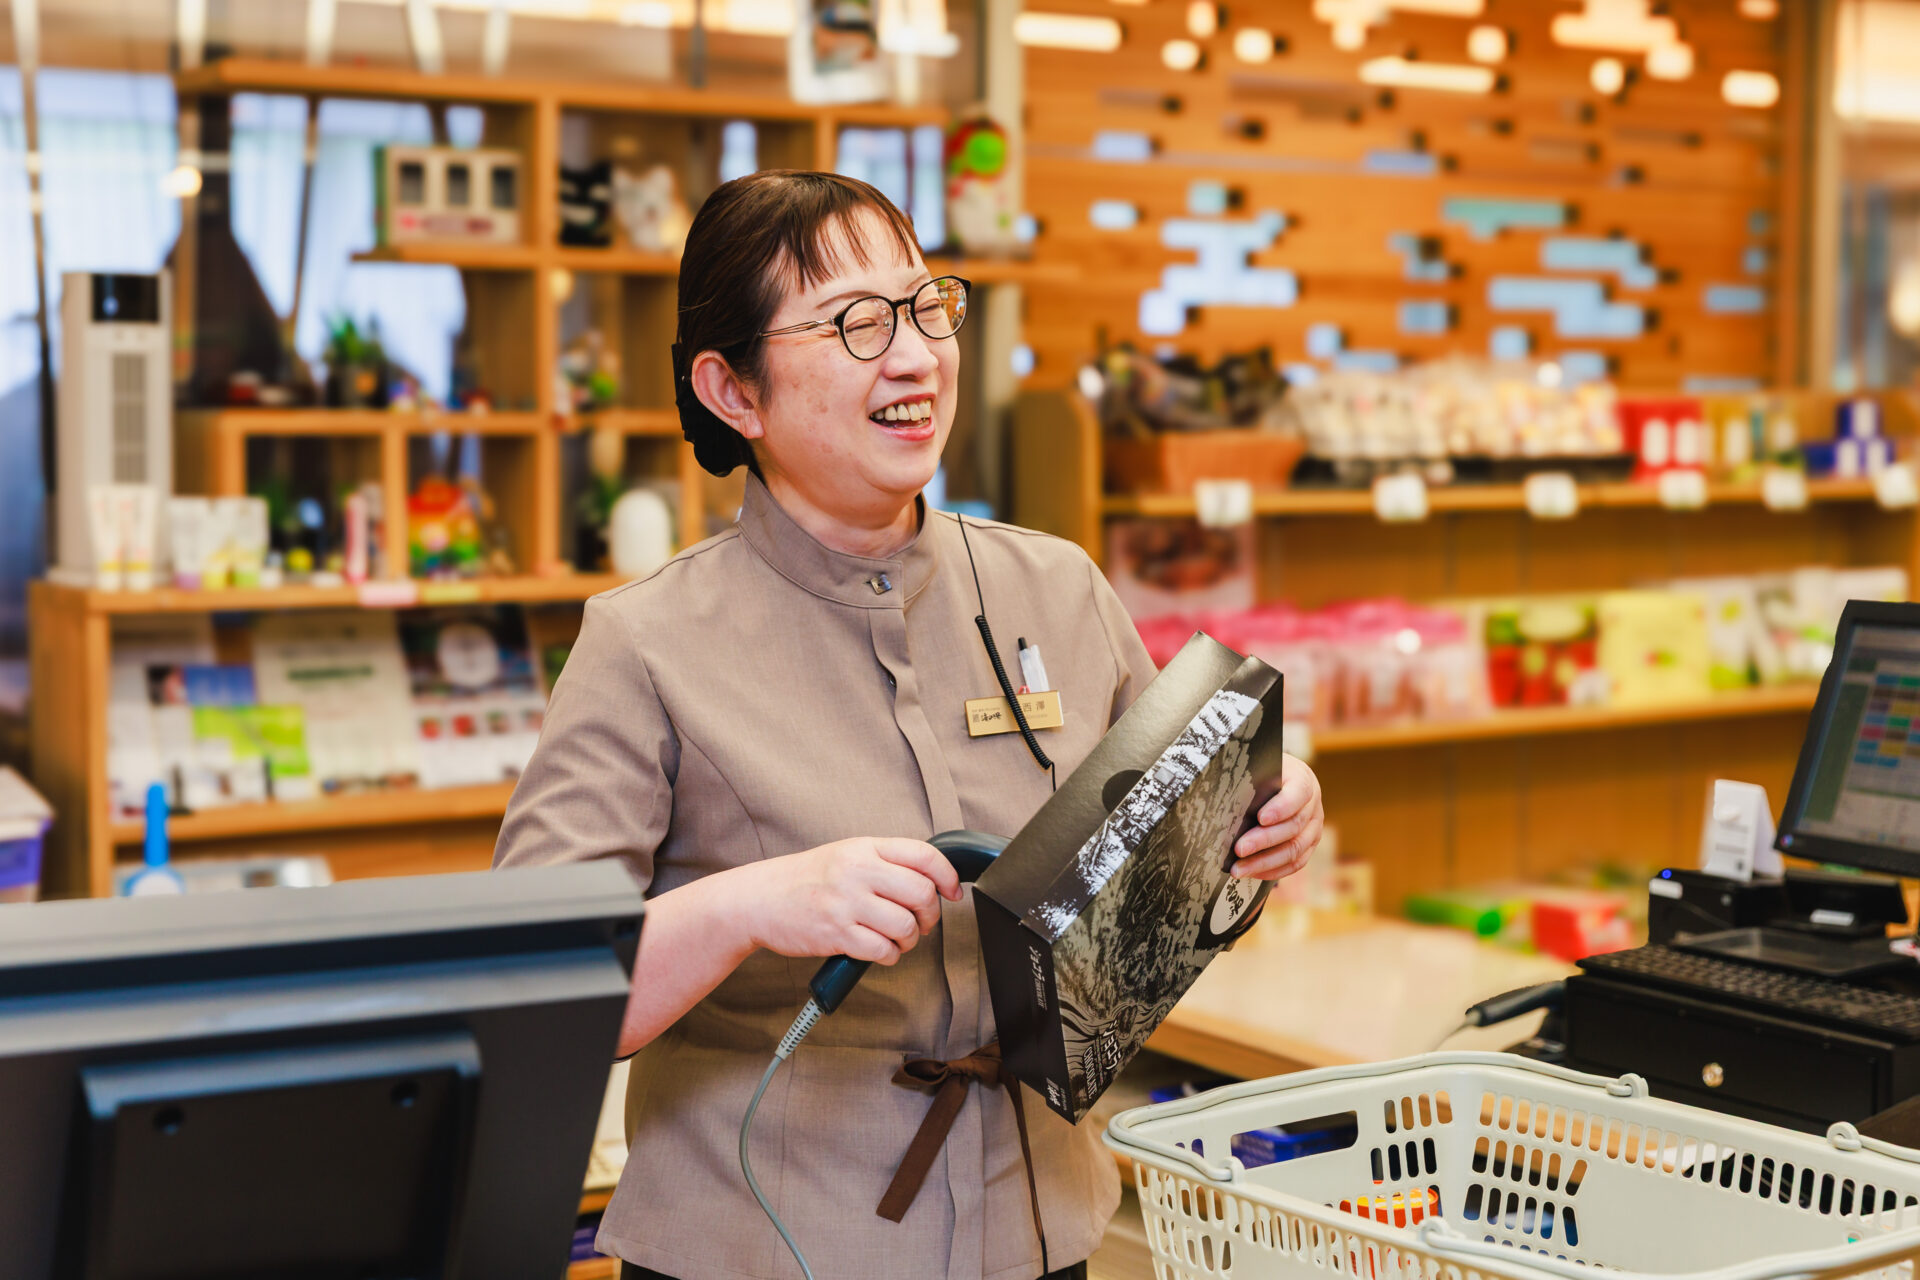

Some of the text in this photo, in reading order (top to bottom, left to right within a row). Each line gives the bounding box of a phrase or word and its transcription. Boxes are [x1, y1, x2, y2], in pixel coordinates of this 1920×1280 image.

[1103, 1020, 1121, 1069] ショコラ
[1083, 1046, 1097, 1099] CHOCOLATE
